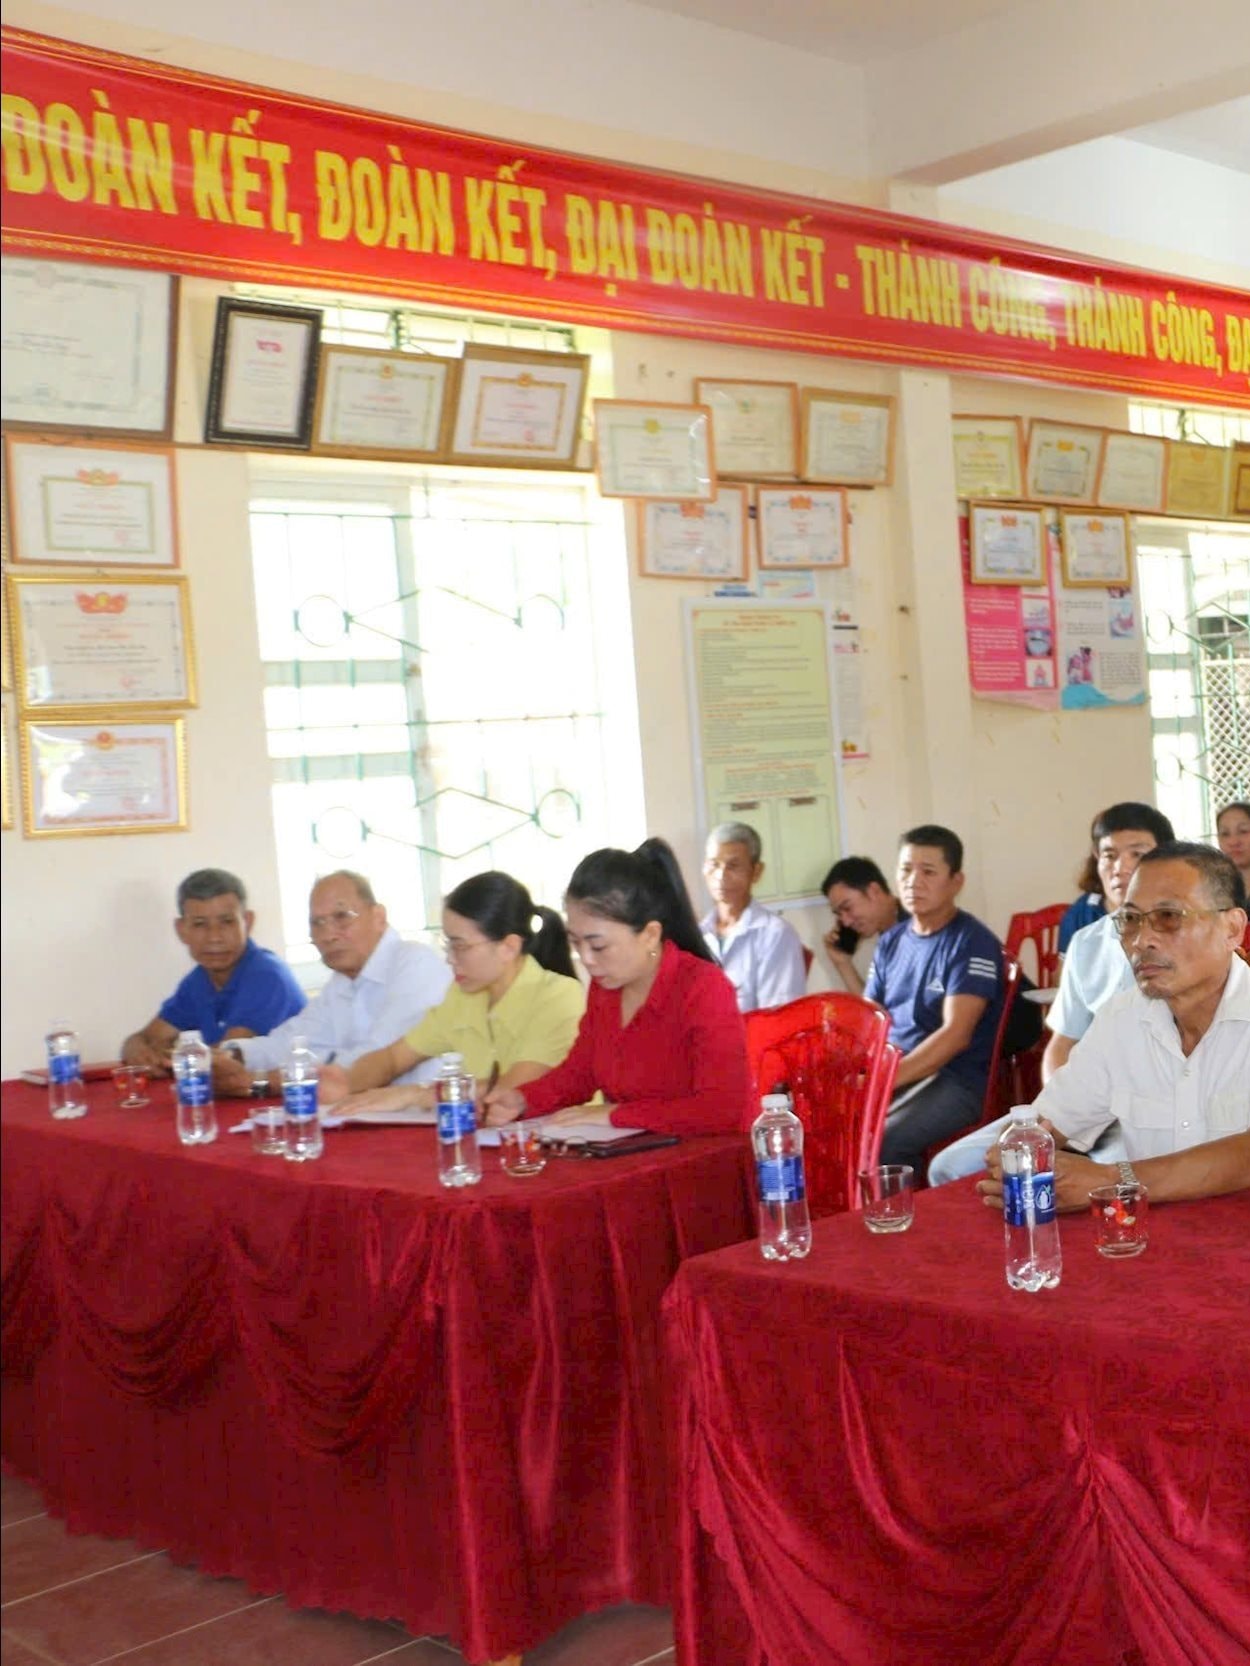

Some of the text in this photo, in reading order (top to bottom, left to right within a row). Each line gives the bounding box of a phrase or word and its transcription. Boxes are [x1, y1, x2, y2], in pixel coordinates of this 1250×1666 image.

[0, 89, 178, 215] ĐOÀN
[190, 109, 303, 246] KẾT,
[315, 144, 454, 256] ĐOÀN
[464, 159, 557, 281] KẾT,
[564, 193, 639, 297] ĐẠI
[646, 202, 755, 298] ĐOÀN
[761, 214, 825, 308] KẾT
[836, 274, 849, 289] -
[856, 239, 962, 328] THÀNH
[968, 256, 1056, 351] CÔNG,
[1060, 276, 1147, 358] THÀNH
[1151, 291, 1222, 378] CÔNG,
